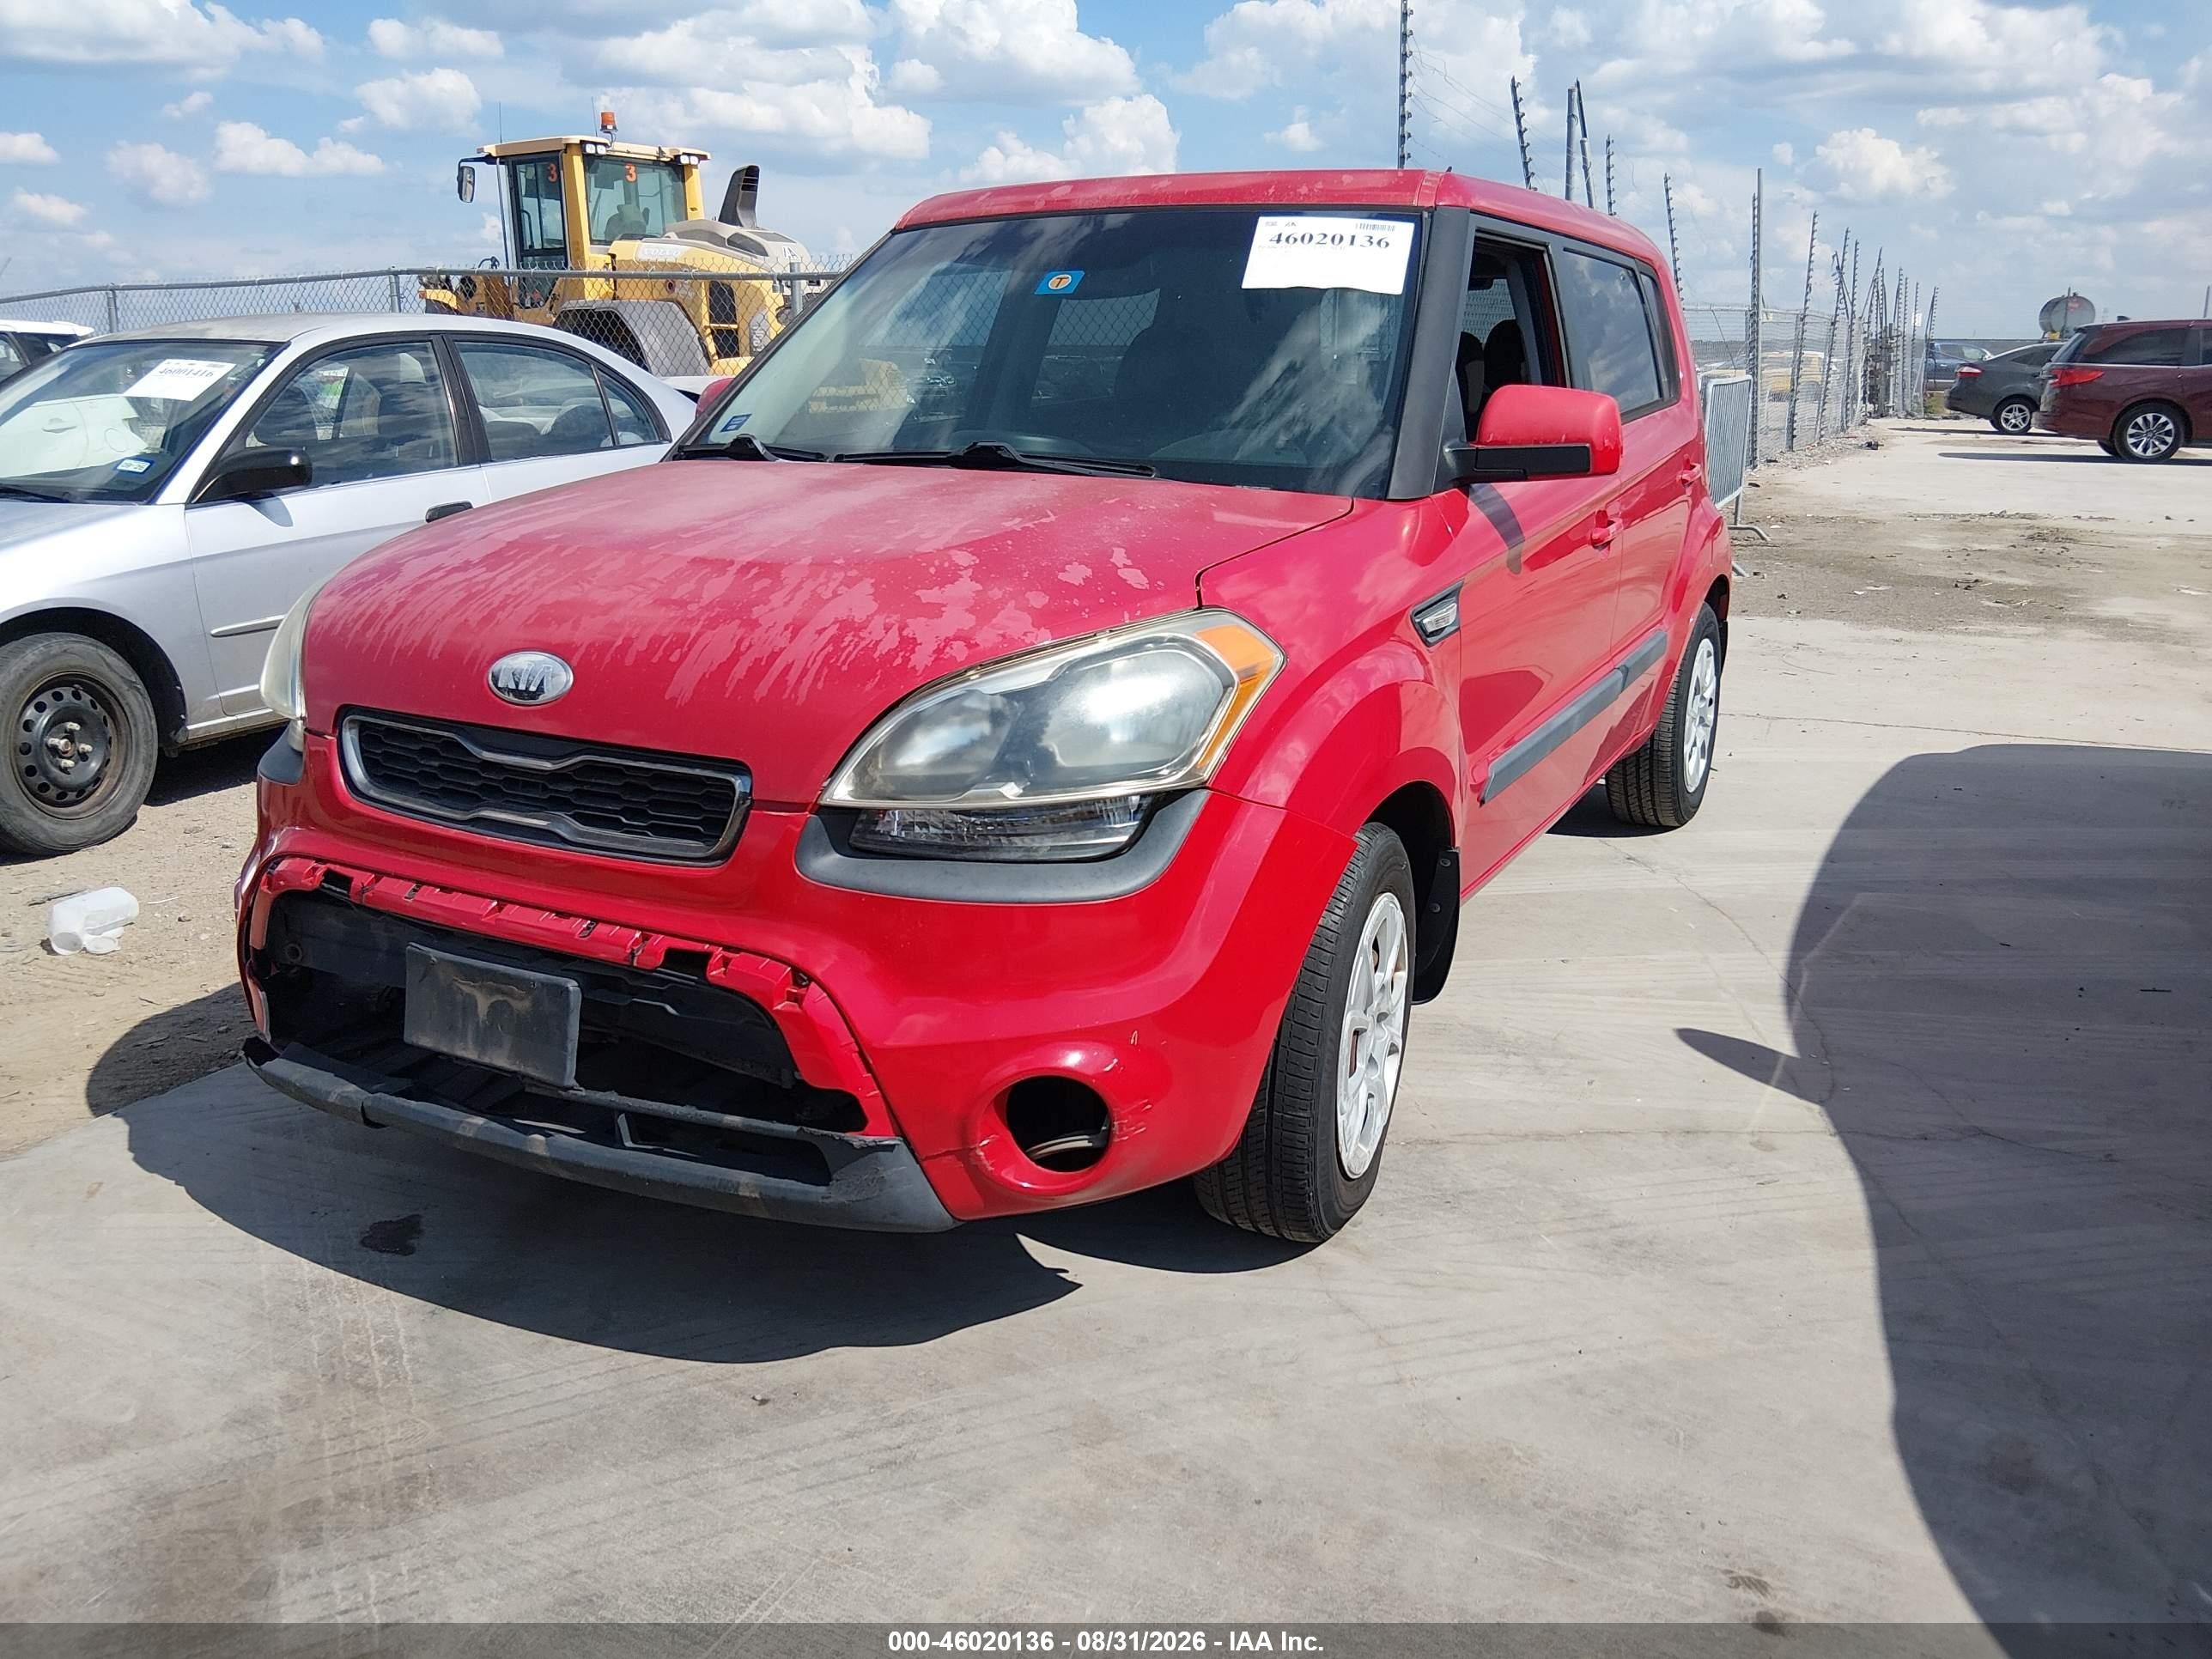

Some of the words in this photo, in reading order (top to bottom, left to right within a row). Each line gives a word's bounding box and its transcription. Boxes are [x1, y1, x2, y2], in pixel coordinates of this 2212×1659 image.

[548, 163, 558, 183] 3
[625, 162, 637, 182] 3
[1269, 232, 1390, 249] 46020136
[1056, 276, 1069, 288] T
[497, 660, 553, 692] KIA
